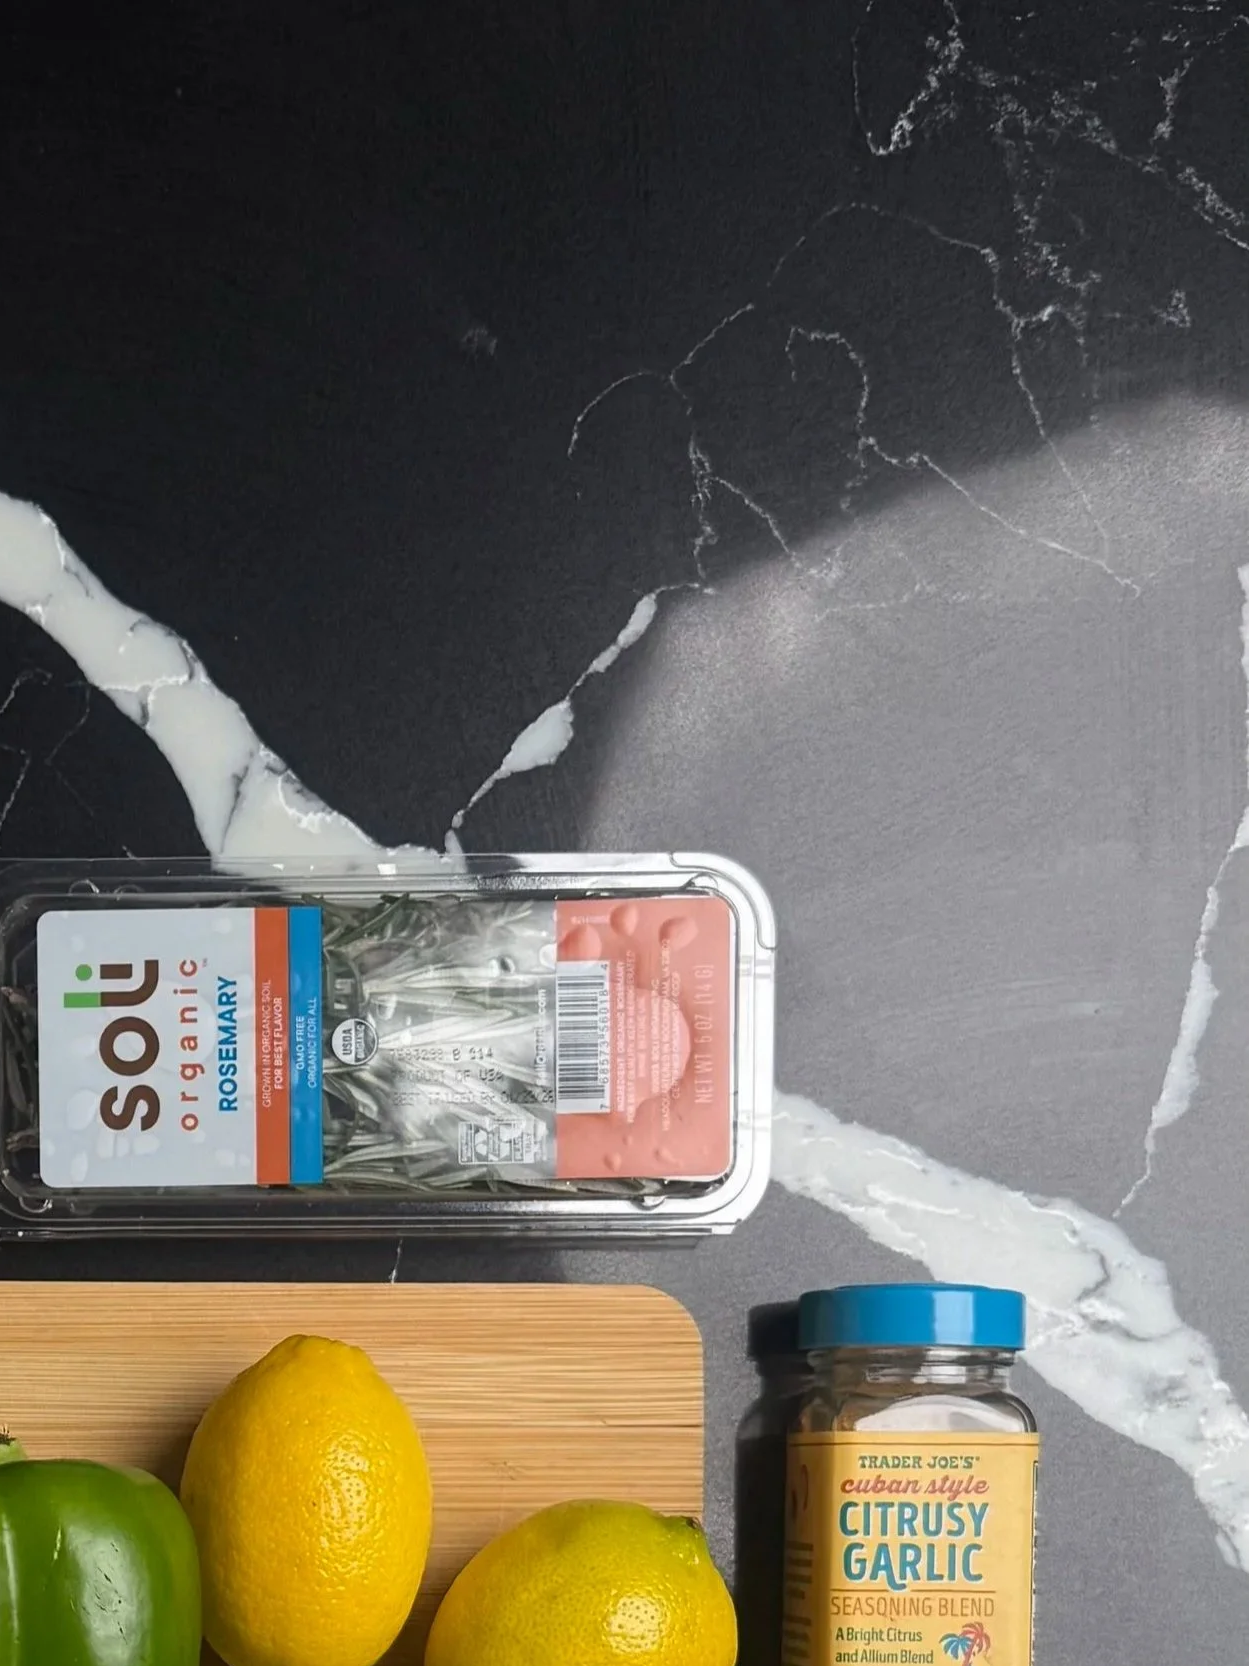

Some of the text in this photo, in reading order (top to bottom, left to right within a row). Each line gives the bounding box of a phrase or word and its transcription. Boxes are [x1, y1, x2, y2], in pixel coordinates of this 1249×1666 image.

[599, 990, 609, 1032] 56018
[695, 985, 713, 1004] (14
[64, 960, 160, 1131] soli
[174, 960, 204, 1131] organic
[218, 977, 237, 1112] ROSEMARY
[262, 980, 272, 1107] GROWN IN ORGANIC SOIL
[273, 998, 283, 1089] FOR BEST FLAVOR
[295, 1016, 305, 1070] GMO FREE
[307, 998, 318, 1088] ORGANIC FOR ALL
[342, 1029, 353, 1056] USDA
[599, 1041, 609, 1084] 68573
[695, 1054, 712, 1074] WT
[695, 1079, 713, 1103] NET
[859, 1456, 975, 1469] TRADER JOE'S
[840, 1475, 989, 1501] cuban style
[839, 1501, 989, 1537] CITRUSY
[843, 1542, 983, 1591] GARLIC
[830, 1596, 994, 1617] SEASONING BLEND
[836, 1627, 922, 1645] A Bright Citrus
[835, 1650, 934, 1664] and Allium Blend
